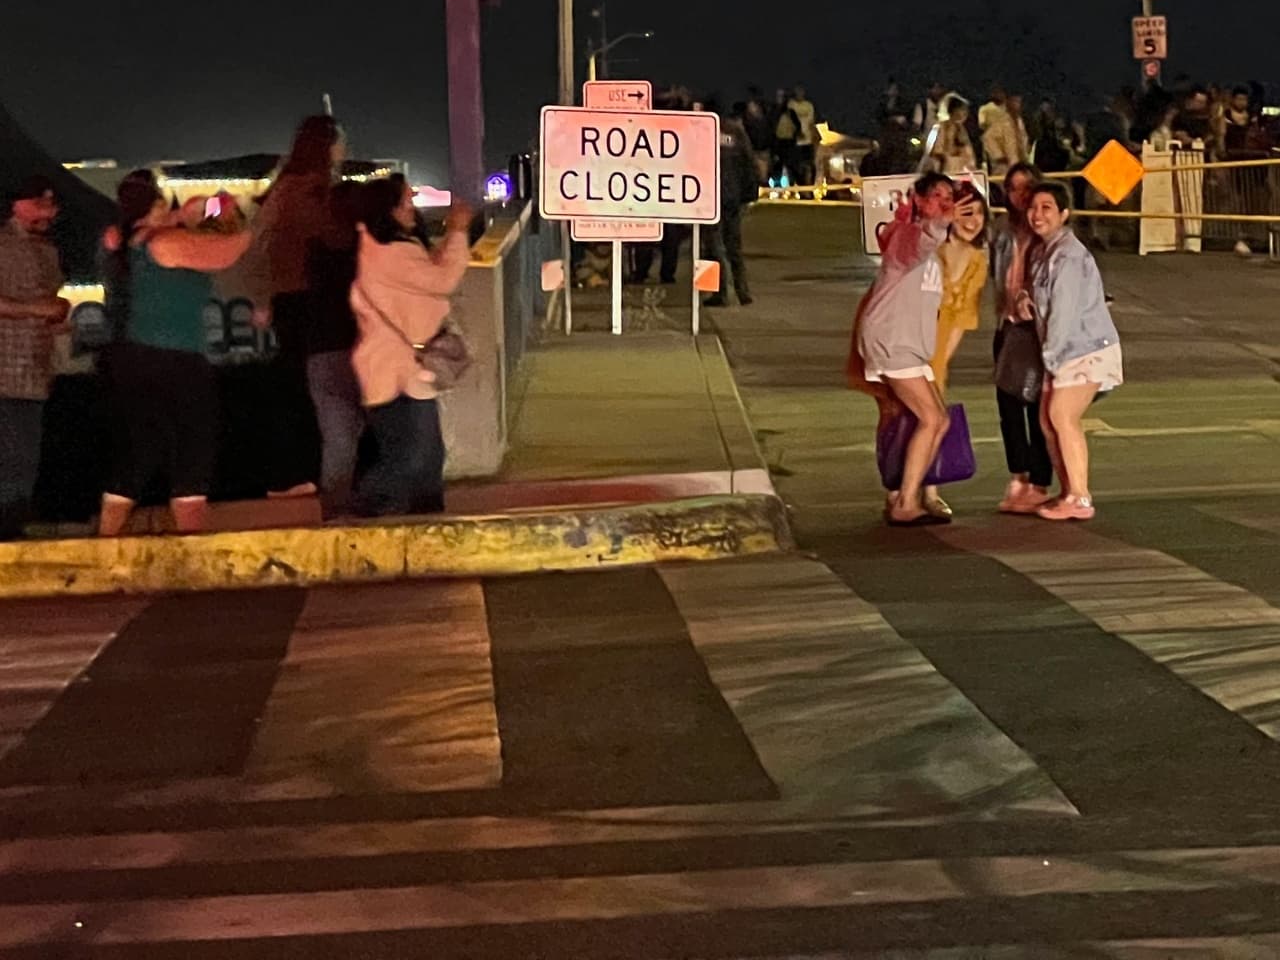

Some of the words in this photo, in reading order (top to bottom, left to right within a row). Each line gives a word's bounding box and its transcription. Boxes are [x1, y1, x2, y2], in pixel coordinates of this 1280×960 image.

[1144, 39, 1156, 55] 5
[608, 89, 627, 101] USE
[581, 127, 680, 159] ROAD
[559, 170, 701, 204] CLOSED
